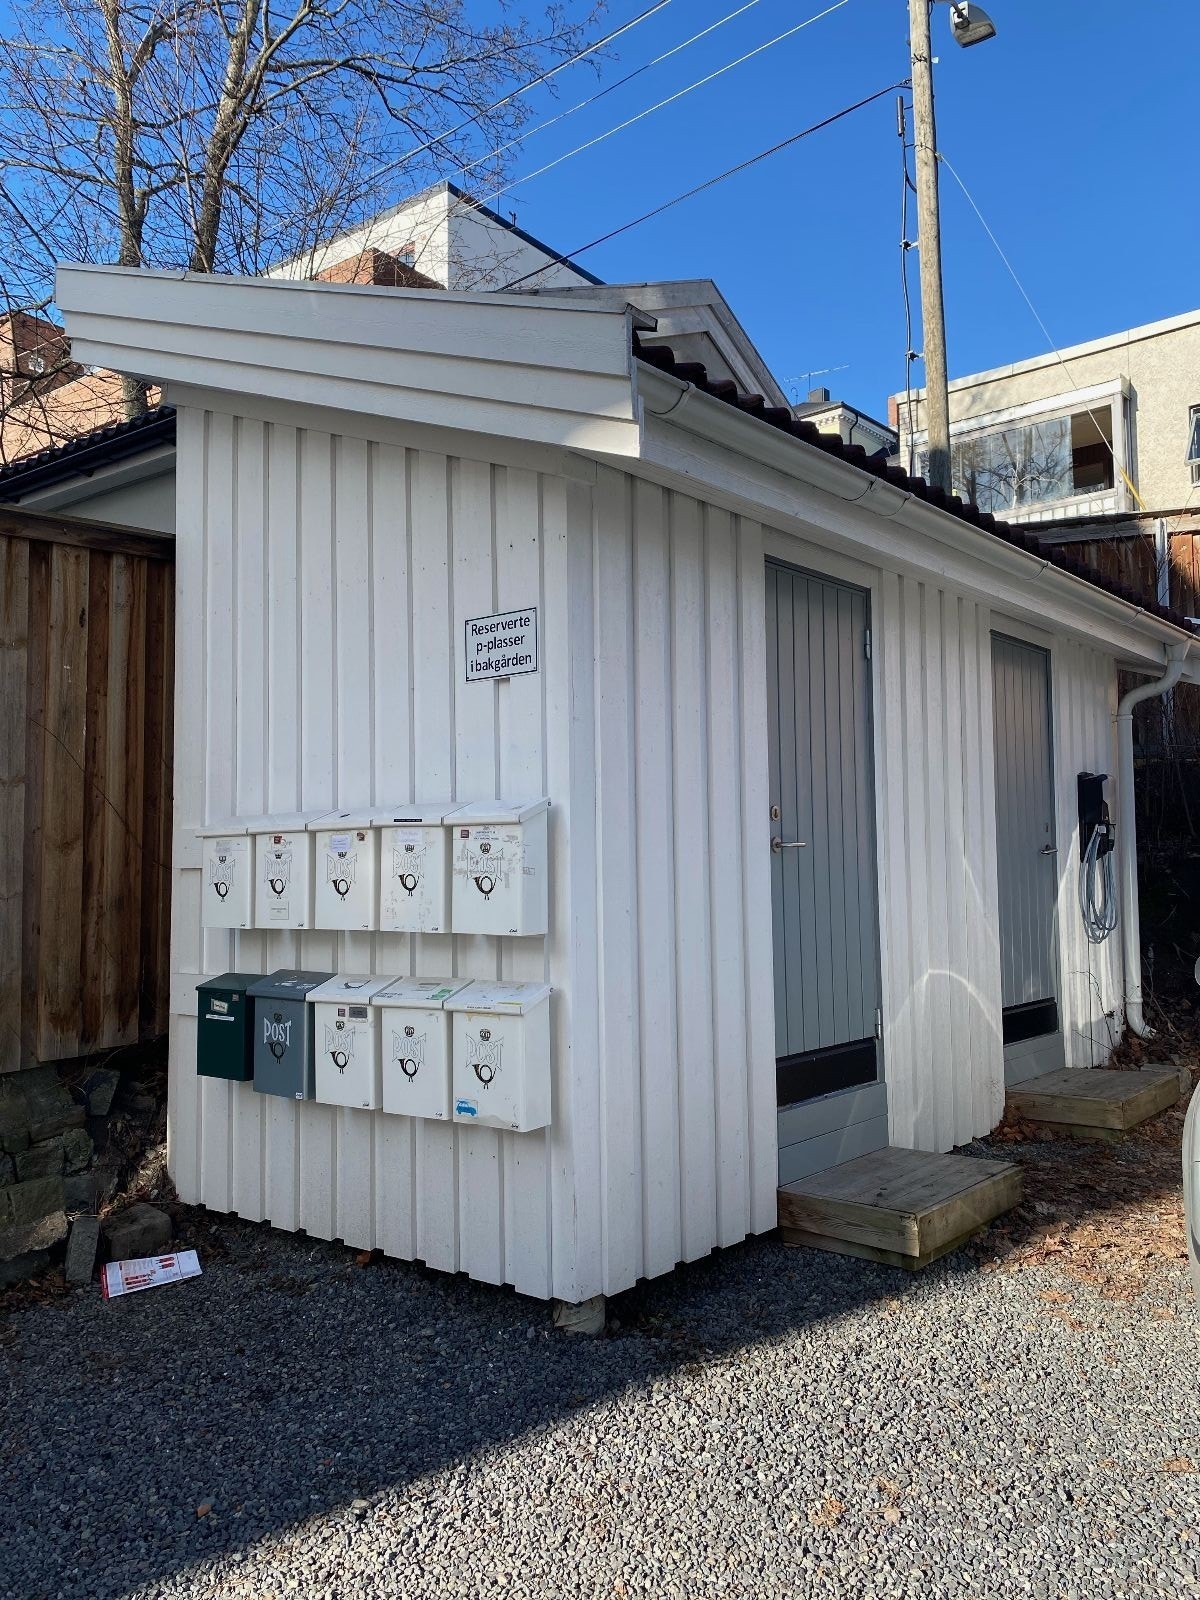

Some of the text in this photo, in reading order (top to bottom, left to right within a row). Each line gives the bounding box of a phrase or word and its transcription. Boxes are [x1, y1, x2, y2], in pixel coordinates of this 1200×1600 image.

[471, 616, 531, 637] Reserverte
[476, 634, 526, 656] p-plasser
[470, 652, 532, 673] i bakgården
[326, 853, 358, 884] POST
[392, 847, 427, 879] POST
[466, 848, 504, 881] POST
[263, 1017, 292, 1047] POST
[324, 1024, 356, 1058] POST
[392, 1030, 427, 1065] POST
[465, 1034, 505, 1072] POST
